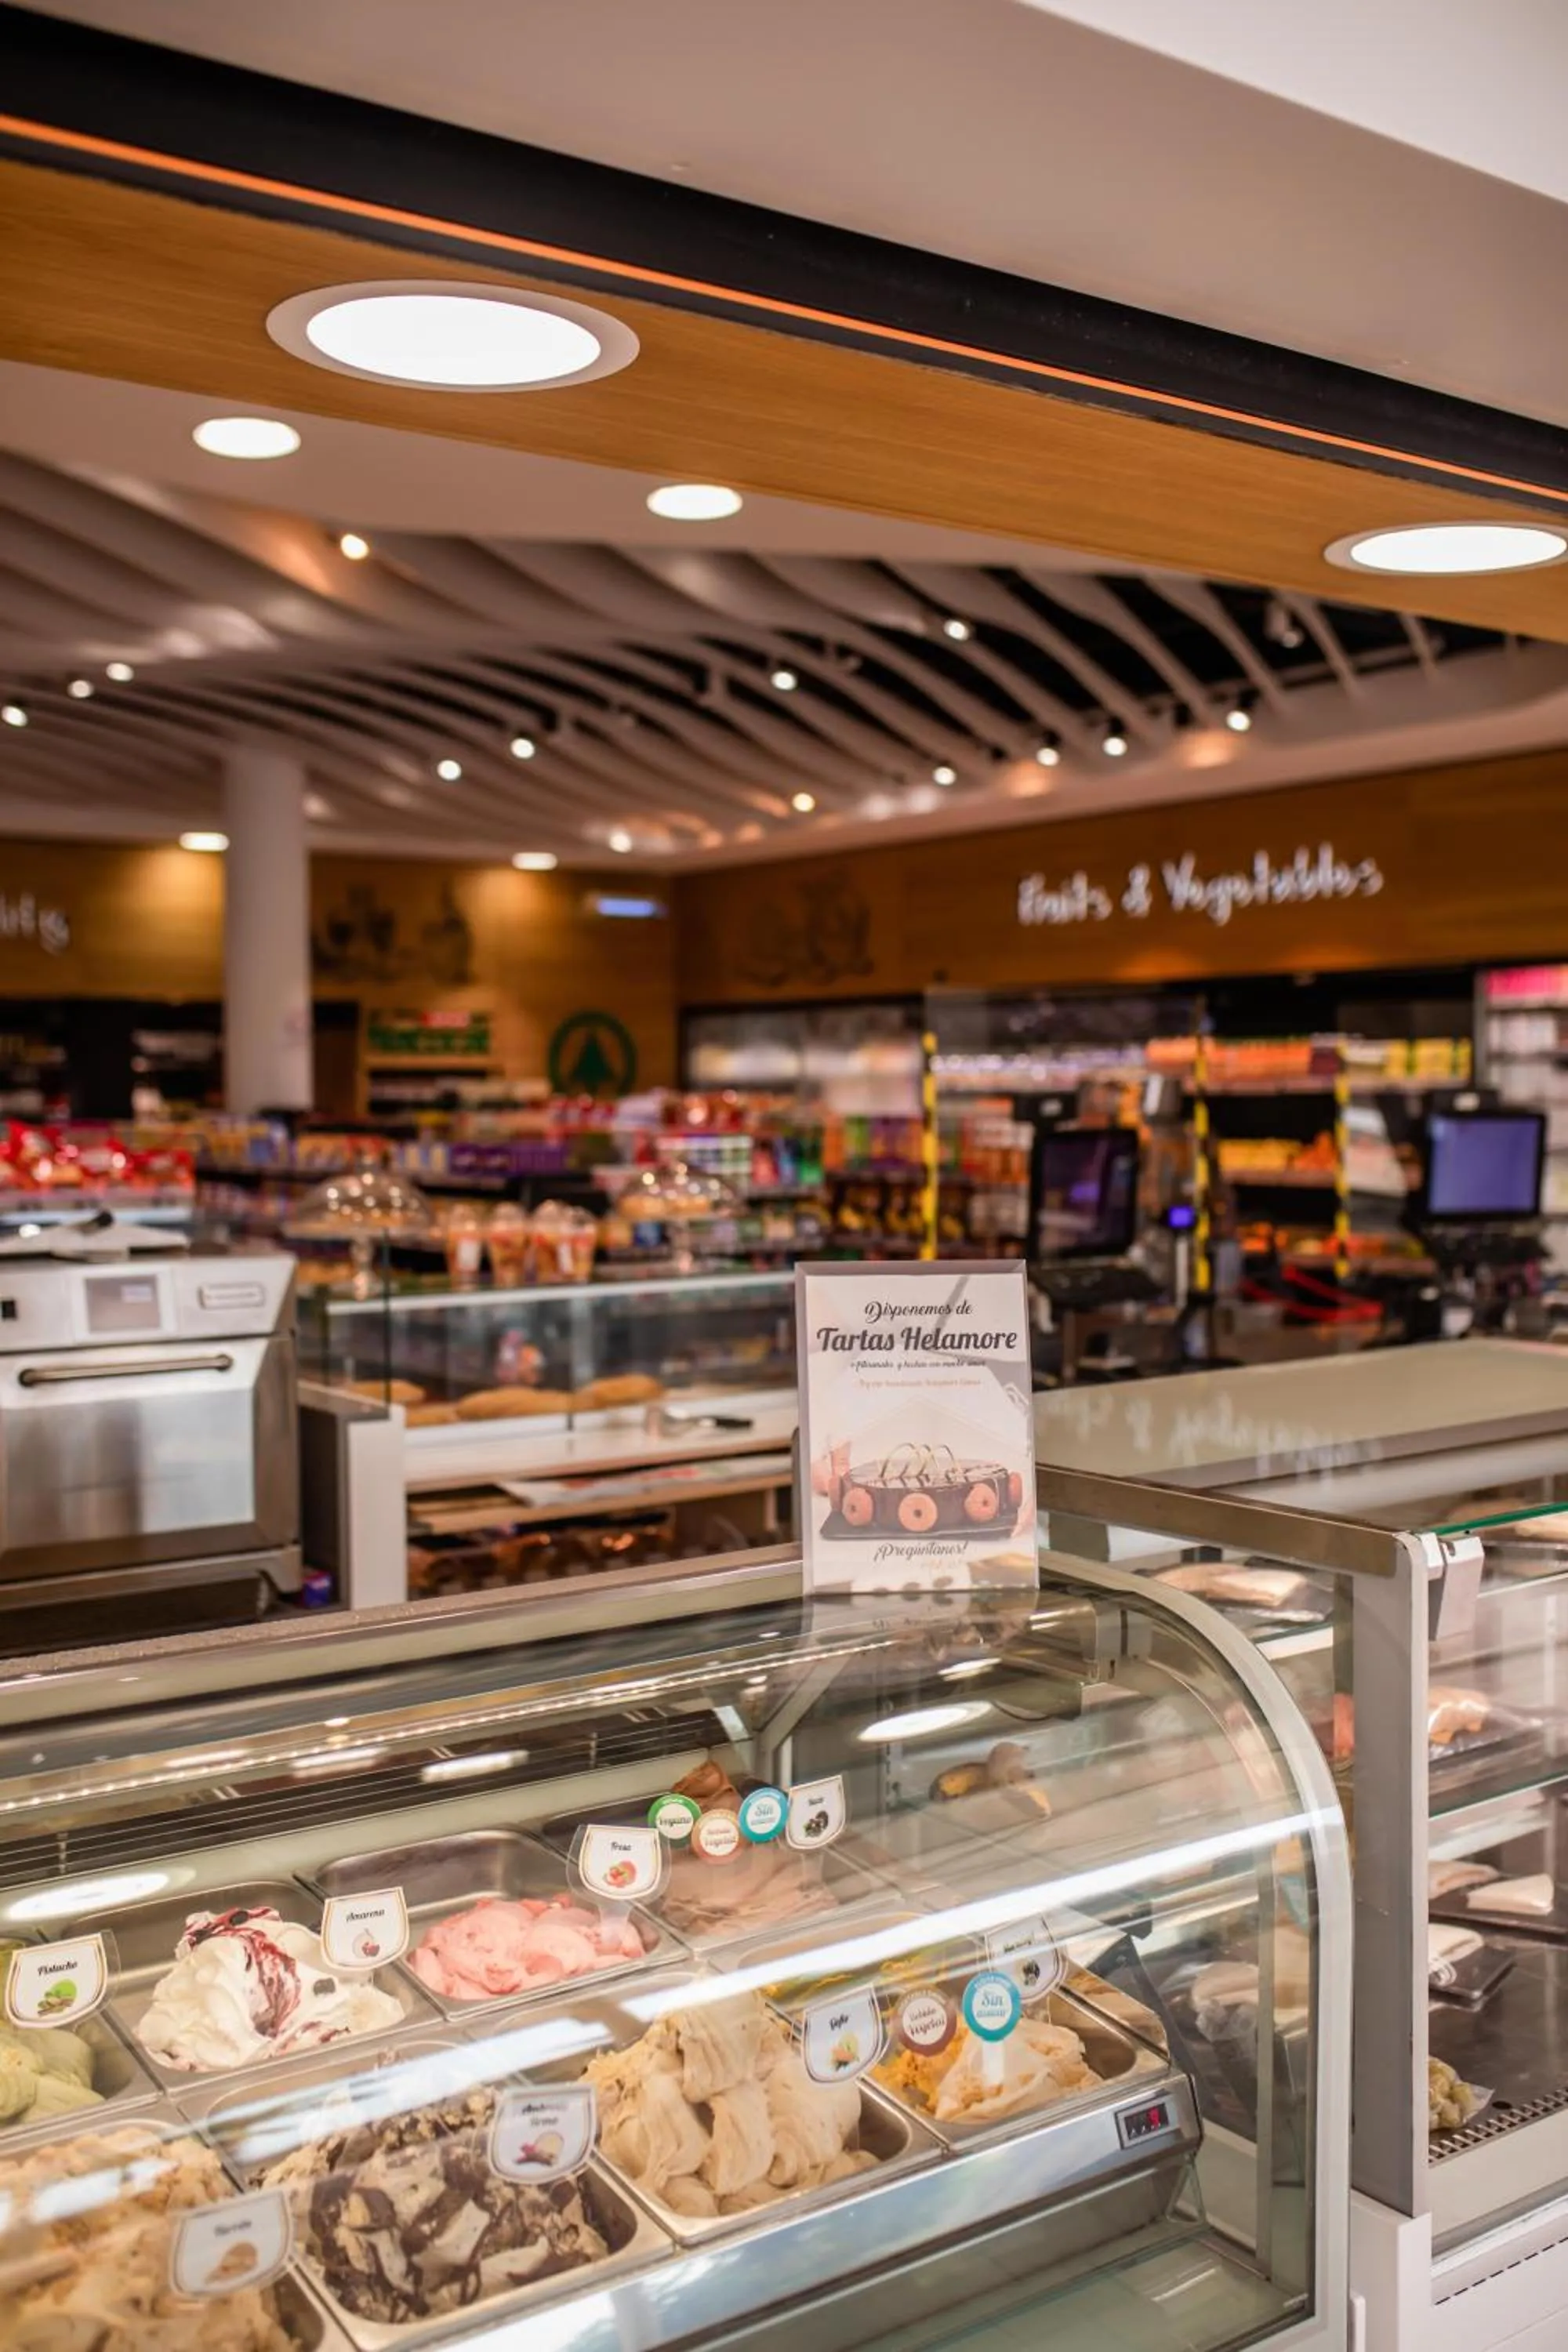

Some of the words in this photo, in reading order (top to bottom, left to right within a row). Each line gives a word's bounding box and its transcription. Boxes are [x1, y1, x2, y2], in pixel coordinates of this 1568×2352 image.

[1018, 869, 1113, 926] Fruits
[1161, 840, 1385, 927] Vegetables
[864, 1300, 952, 1324] Disponemos
[955, 1298, 974, 1316] de
[816, 1327, 895, 1352] Tartas
[900, 1326, 1018, 1352] Helamore
